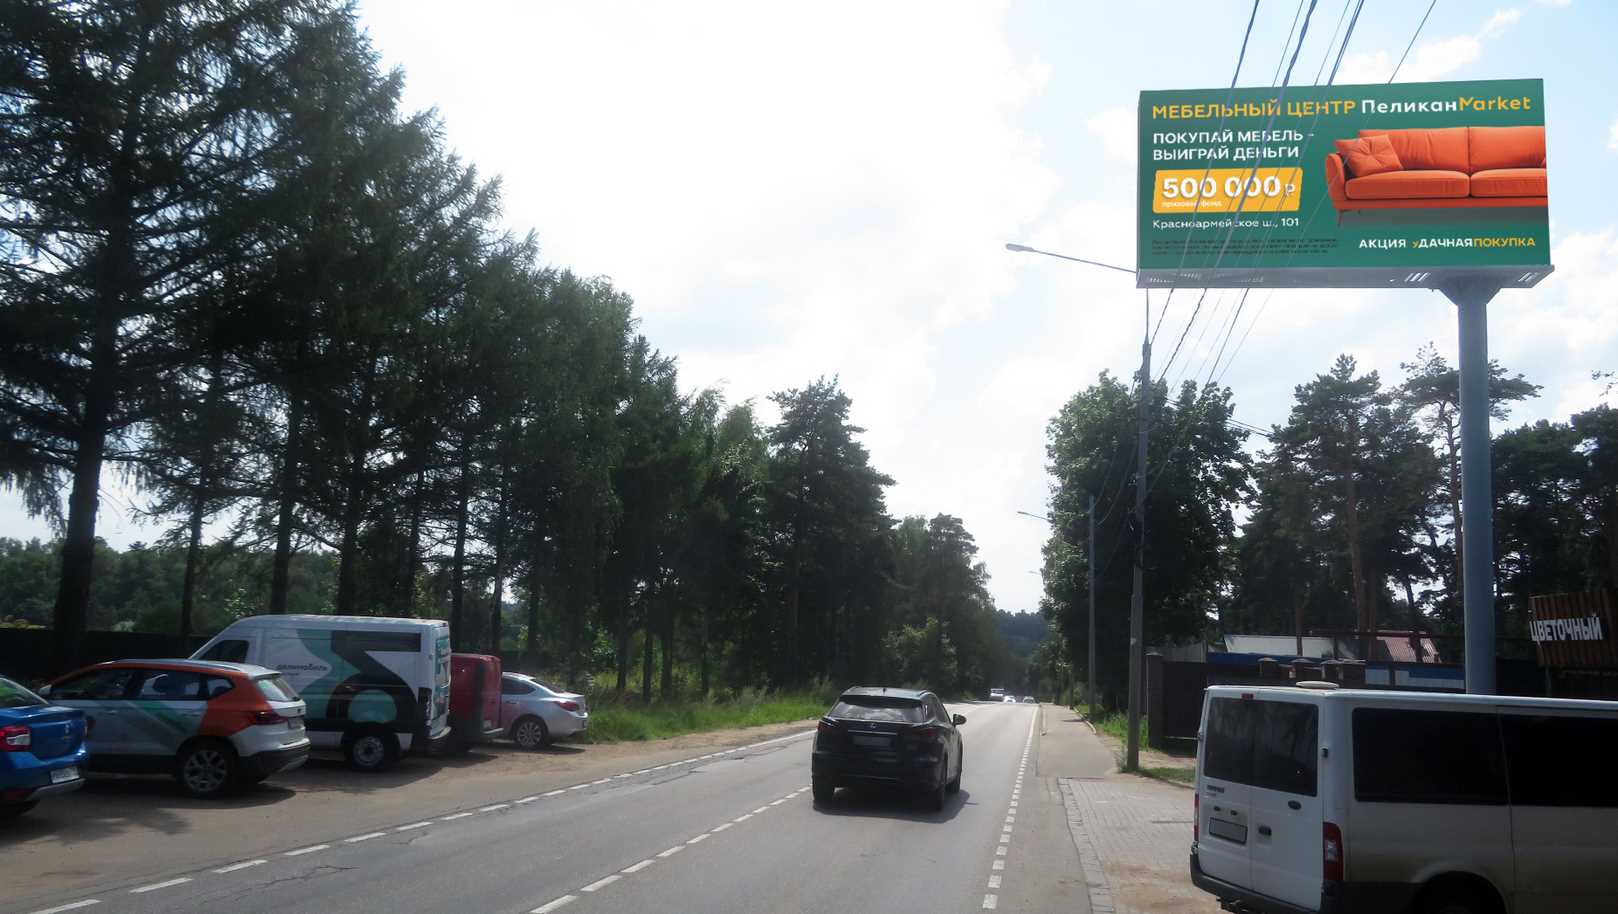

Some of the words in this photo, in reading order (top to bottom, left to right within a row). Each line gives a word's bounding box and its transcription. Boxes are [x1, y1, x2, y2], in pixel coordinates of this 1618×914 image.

[1152, 99, 1281, 119] МЕБЕЛЬНЫЙ
[1287, 100, 1356, 117] ЦЕНТР
[1153, 130, 1233, 144] ПОКУПАЙ
[1238, 130, 1303, 142] МЕБЕЛЬ
[1153, 146, 1229, 161] ВЫИГРАЙ
[1233, 147, 1299, 161] ДЕНЬГИ
[1162, 177, 1217, 198] 500
[1224, 175, 1281, 197] 000
[1281, 217, 1299, 227] 101
[1358, 239, 1407, 250] АКЦИЯ
[1529, 612, 1603, 646] ЦВЕТОЧНЫЙ
